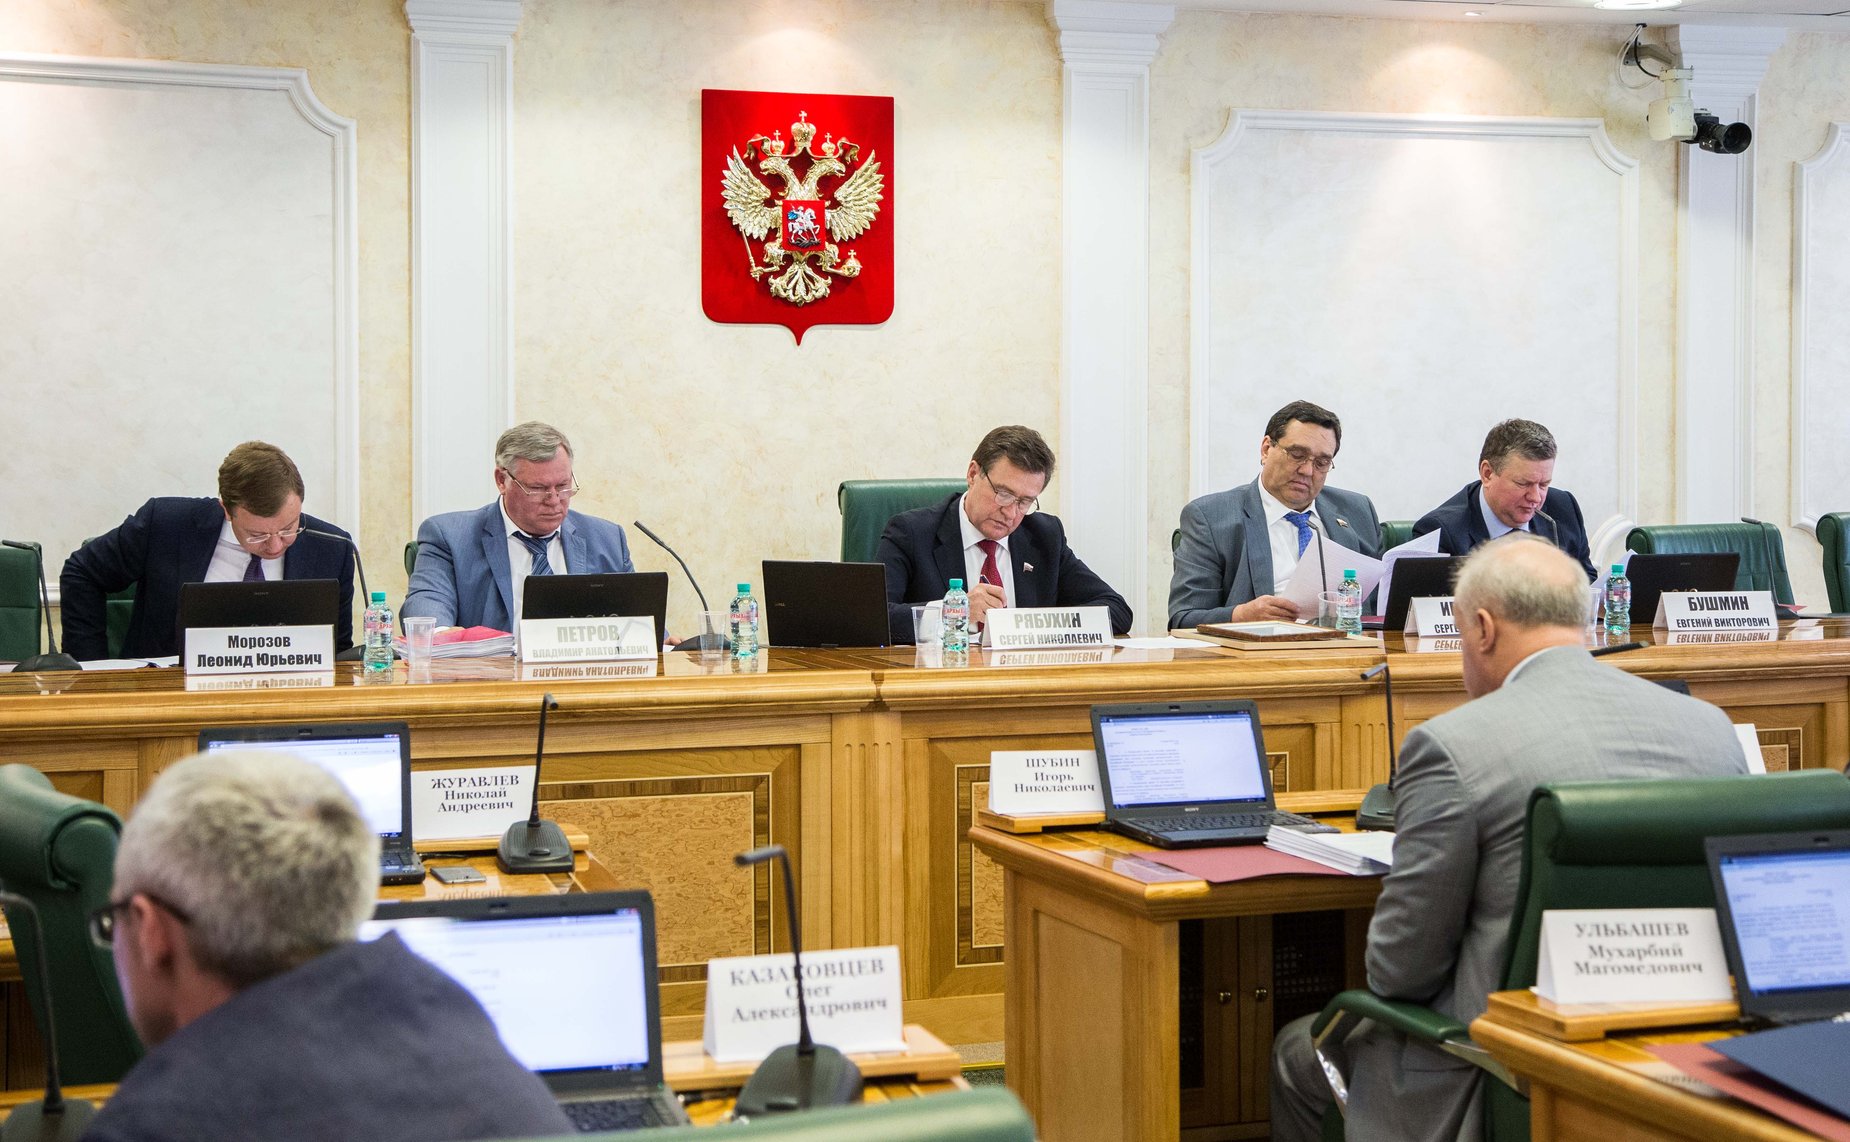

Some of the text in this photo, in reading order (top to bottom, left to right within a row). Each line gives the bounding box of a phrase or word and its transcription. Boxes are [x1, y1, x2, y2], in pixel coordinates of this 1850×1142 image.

[1687, 596, 1749, 611] БУШМИН
[1014, 612, 1082, 629] РЯБУХИН
[1676, 617, 1770, 628] ЕВГЕНИЙ ВИКТОРОВИЧ
[557, 624, 619, 643] ПЕТРОВ
[1434, 623, 1460, 634] СЕРГЕ
[227, 635, 291, 650] Морозов
[999, 632, 1103, 645] СЕРГЕЙ НИКОЛАЕВИЧ
[532, 645, 649, 659] ВЛАДИМИР АНАТОЛЬЕВИЧ
[197, 653, 322, 668] Леонид Юрьевич
[1026, 758, 1080, 768] ШУБИН
[431, 775, 520, 789] ЖУРАВЛЕВ
[1034, 772, 1074, 783] Игорь
[445, 787, 507, 800] Николай
[1014, 783, 1095, 793] Николаевич
[438, 801, 513, 813] Андреевич
[1574, 922, 1690, 938] УЛЬБАШЕВ
[1588, 943, 1684, 961] Мухарбий
[730, 958, 885, 986] КАЗАОВЦЕВ
[1574, 961, 1703, 976] Магомедович
